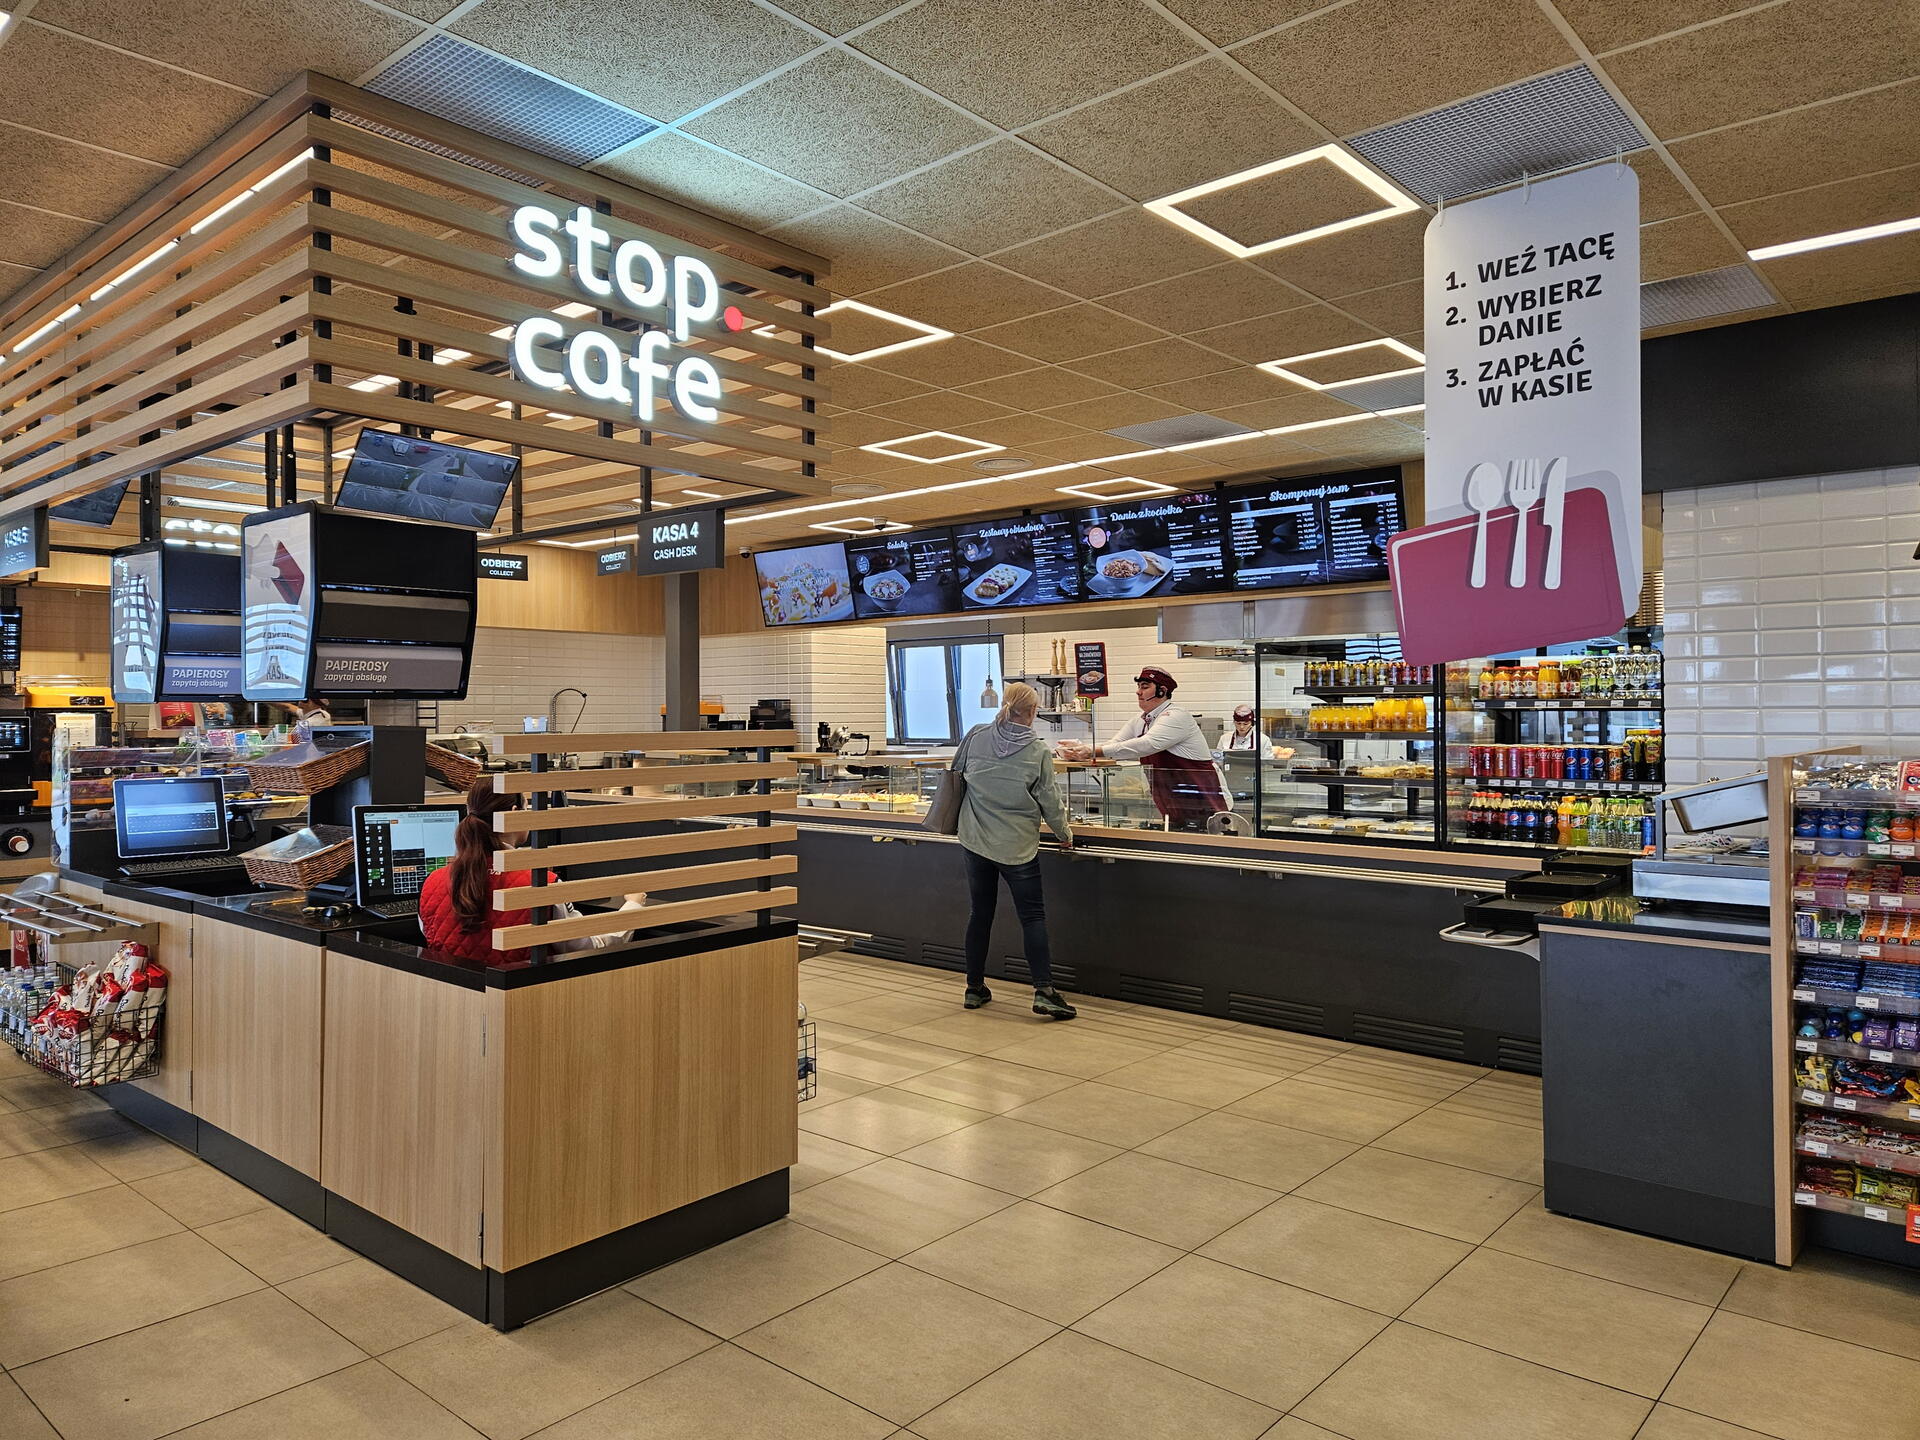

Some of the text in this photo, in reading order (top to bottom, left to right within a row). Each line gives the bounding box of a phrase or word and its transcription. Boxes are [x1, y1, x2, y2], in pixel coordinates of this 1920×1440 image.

[1445, 232, 1615, 291] 1. WEŹ TACĘ
[1445, 274, 1602, 326] 2. WYBIERZ
[1479, 310, 1562, 346] DANIE
[510, 317, 721, 421] cafe
[1445, 337, 1585, 388] 3. ZAPŁAĆ
[1478, 369, 1593, 408] W KASIE
[1110, 510, 1137, 521] Dania
[652, 521, 700, 544] KASA 4
[653, 545, 697, 561] CASH DESK
[480, 558, 523, 570] ODBIERZ
[489, 569, 514, 577] COLLECT
[171, 668, 230, 679] PAPIEROSY
[324, 659, 390, 672] PAPIEROSY
[171, 679, 199, 688] zapytaj
[323, 672, 388, 683] zapytaj obsługę
